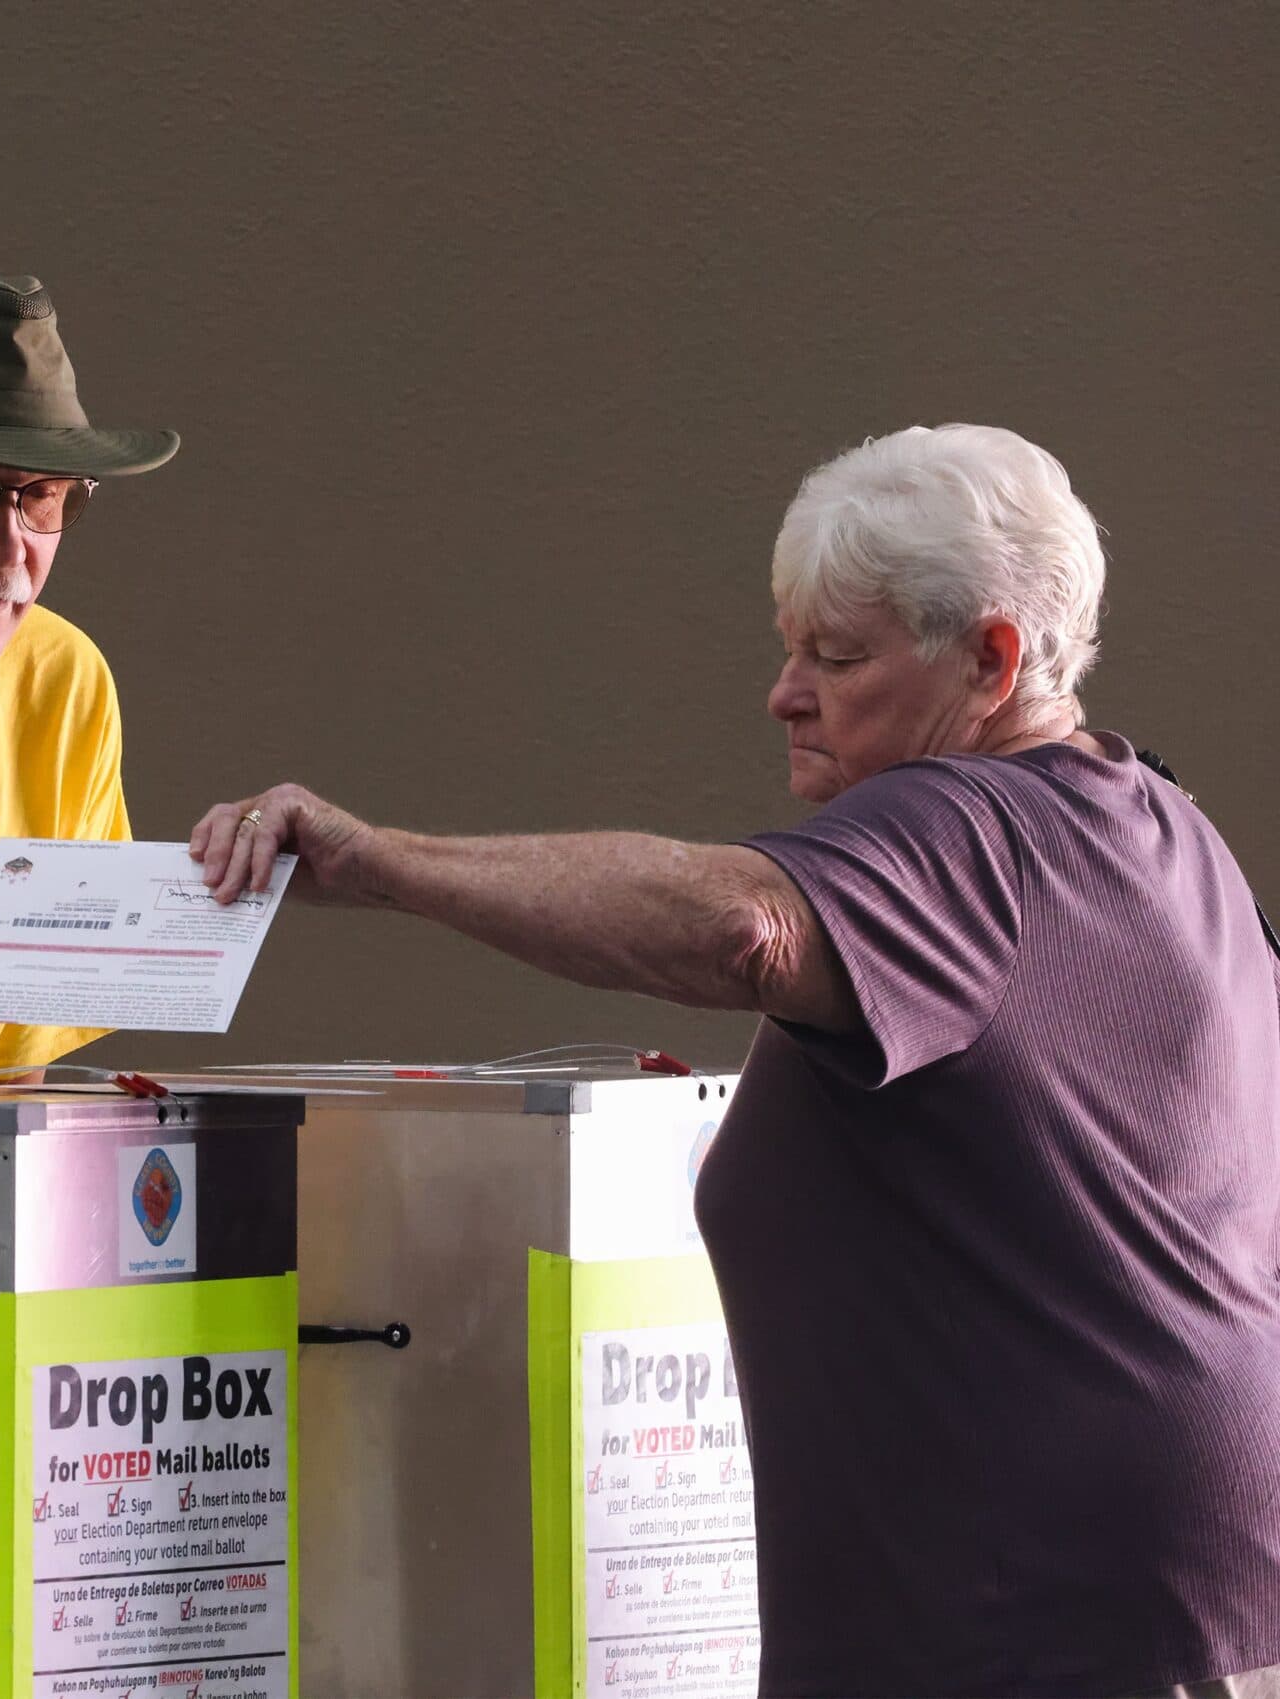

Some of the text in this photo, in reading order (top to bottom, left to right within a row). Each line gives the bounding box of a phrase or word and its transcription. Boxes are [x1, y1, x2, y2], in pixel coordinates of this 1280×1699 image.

[602, 1342, 711, 1419] Drop
[49, 1356, 272, 1444] Drop Box
[601, 1430, 630, 1456] for
[633, 1424, 695, 1454] VOTED
[699, 1421, 737, 1449] Mail
[49, 1443, 270, 1482] for VOTED Mail ballots
[609, 1475, 629, 1489] Seal
[667, 1472, 676, 1486] 2.
[678, 1471, 696, 1488] Sign
[47, 1488, 286, 1518] 1. Seal 2. Sign 3. Insert into the box
[607, 1489, 752, 1516] your Election Department retur
[54, 1512, 267, 1546] your Election Department return envelope
[629, 1511, 751, 1536] containing your voted mail
[79, 1538, 245, 1566] containing your voted mail ballot
[606, 1547, 755, 1572] Urna de Entrega de Boletas por Corre
[53, 1573, 267, 1602] Urna de Entrega de Boletas por Correo VOTADAS
[624, 1583, 643, 1595] Selle
[681, 1579, 702, 1590] Firme
[73, 1615, 94, 1627] Selle
[127, 1611, 134, 1623] 2.
[135, 1610, 158, 1622] Firme
[200, 1604, 228, 1617] Inserte
[230, 1605, 239, 1615] en
[240, 1602, 248, 1614] la
[249, 1602, 267, 1614] urna
[148, 1675, 158, 1688] ng
[159, 1669, 203, 1684] IBINOTONG
